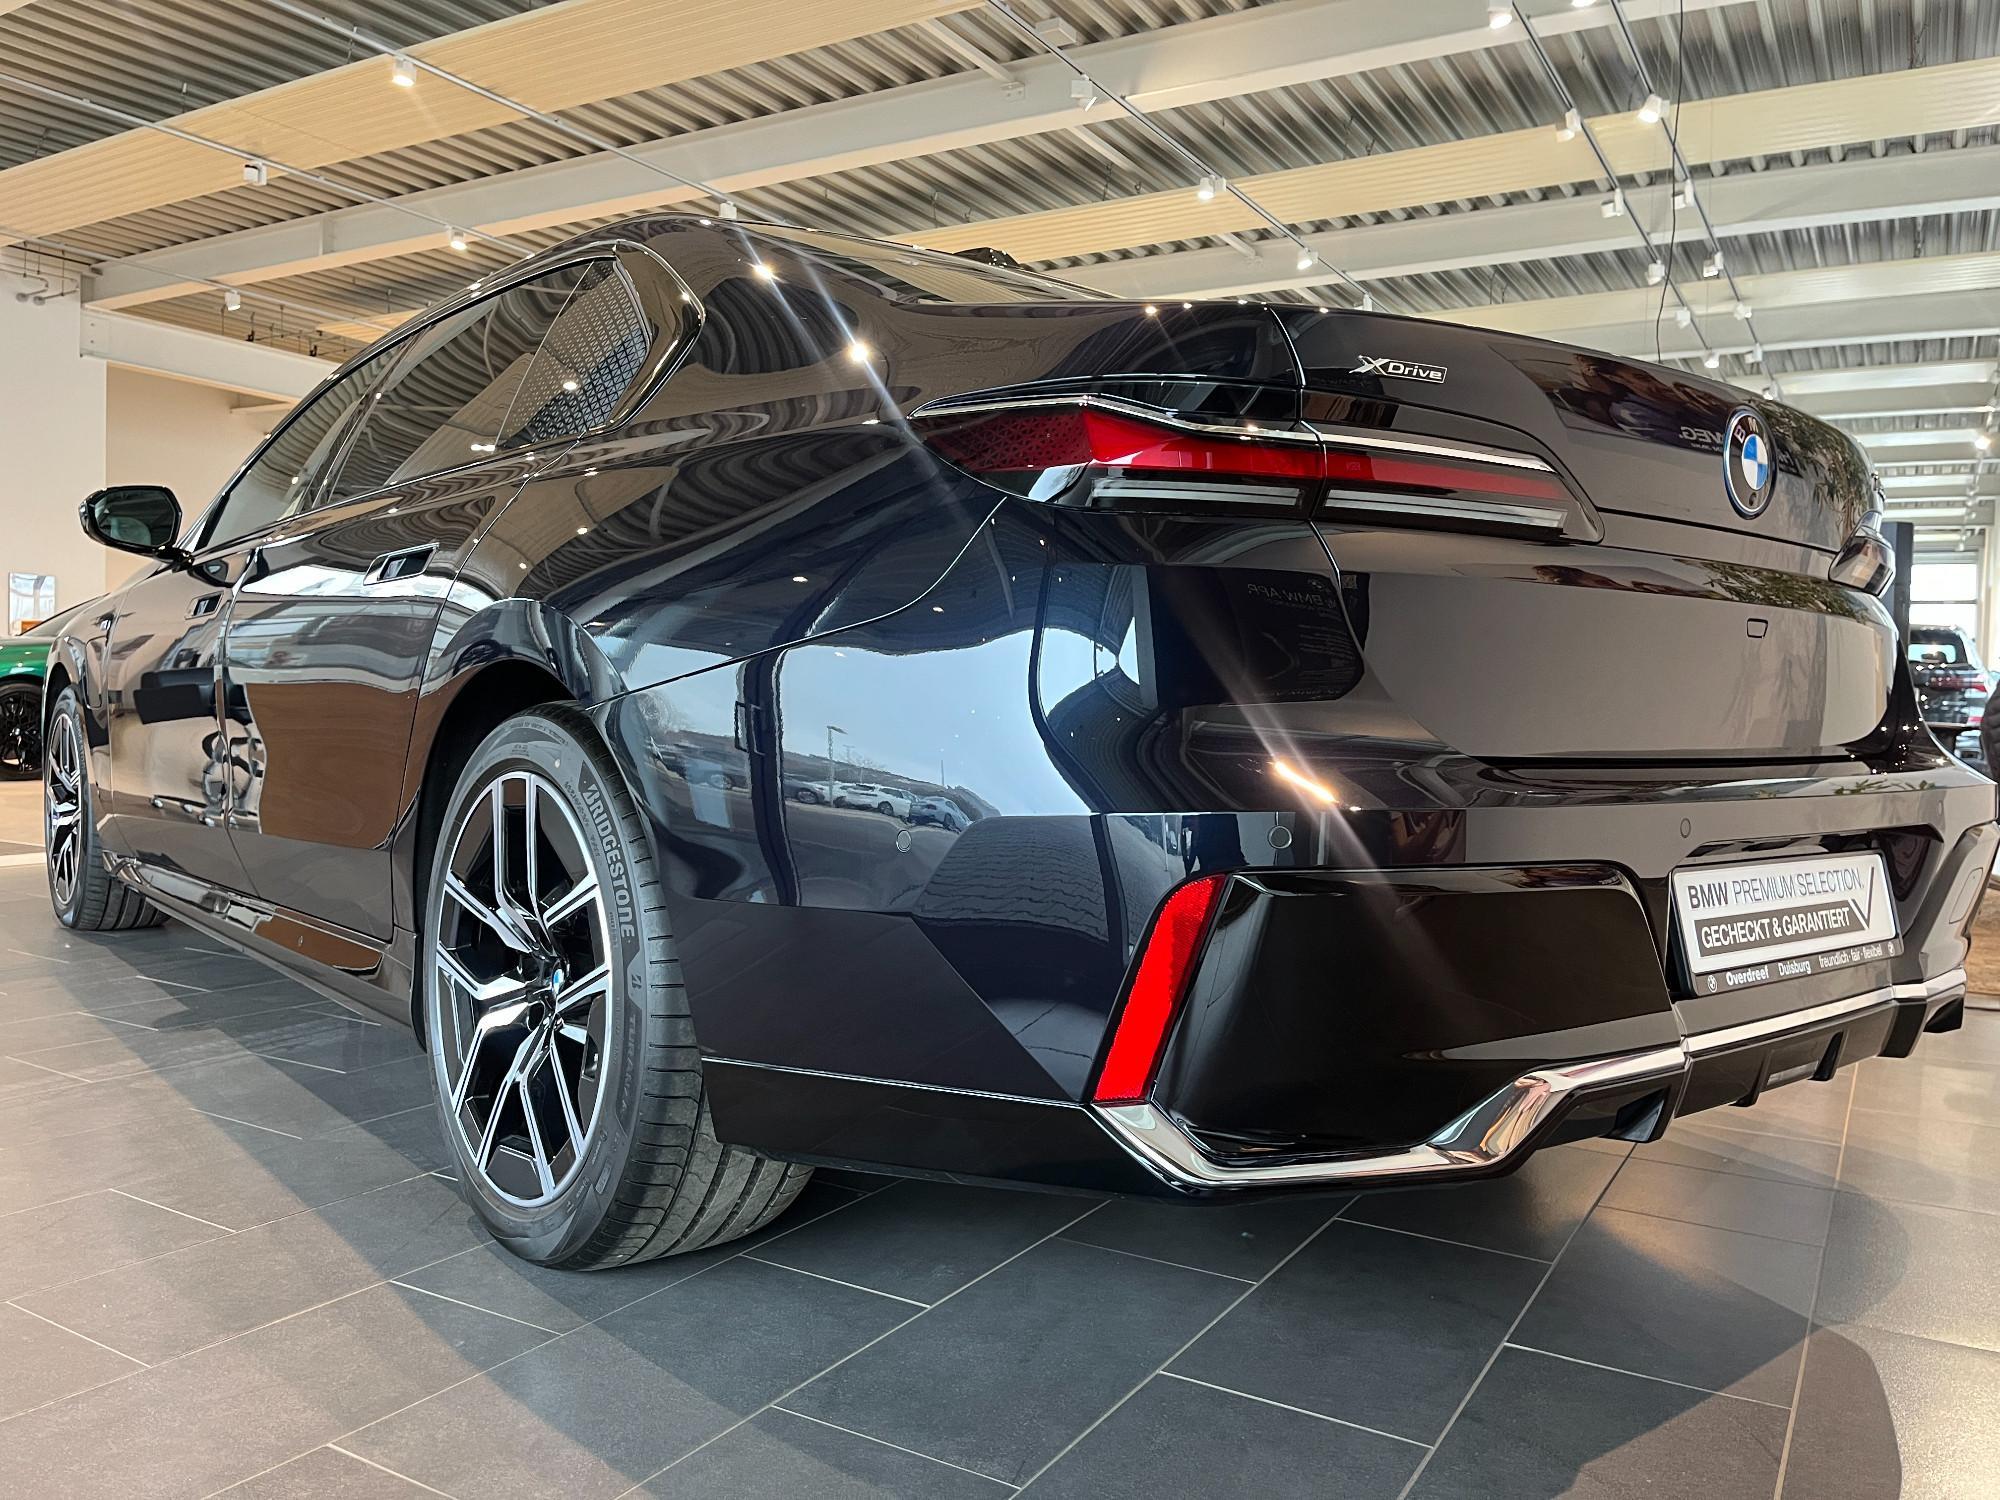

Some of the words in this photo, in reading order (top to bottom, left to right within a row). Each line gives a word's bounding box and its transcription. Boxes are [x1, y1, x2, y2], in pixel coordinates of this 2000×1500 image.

[583, 784, 635, 938] BRIDGESTONE
[1688, 882, 1729, 909] BMW
[1732, 874, 1796, 904] PREMIUM
[1701, 918, 1770, 949] GECHECKT
[1772, 917, 1783, 938] &
[1782, 907, 1850, 936] GARANTIERT
[1725, 964, 1769, 986] Overdreef
[1777, 960, 1812, 975] Duisburg
